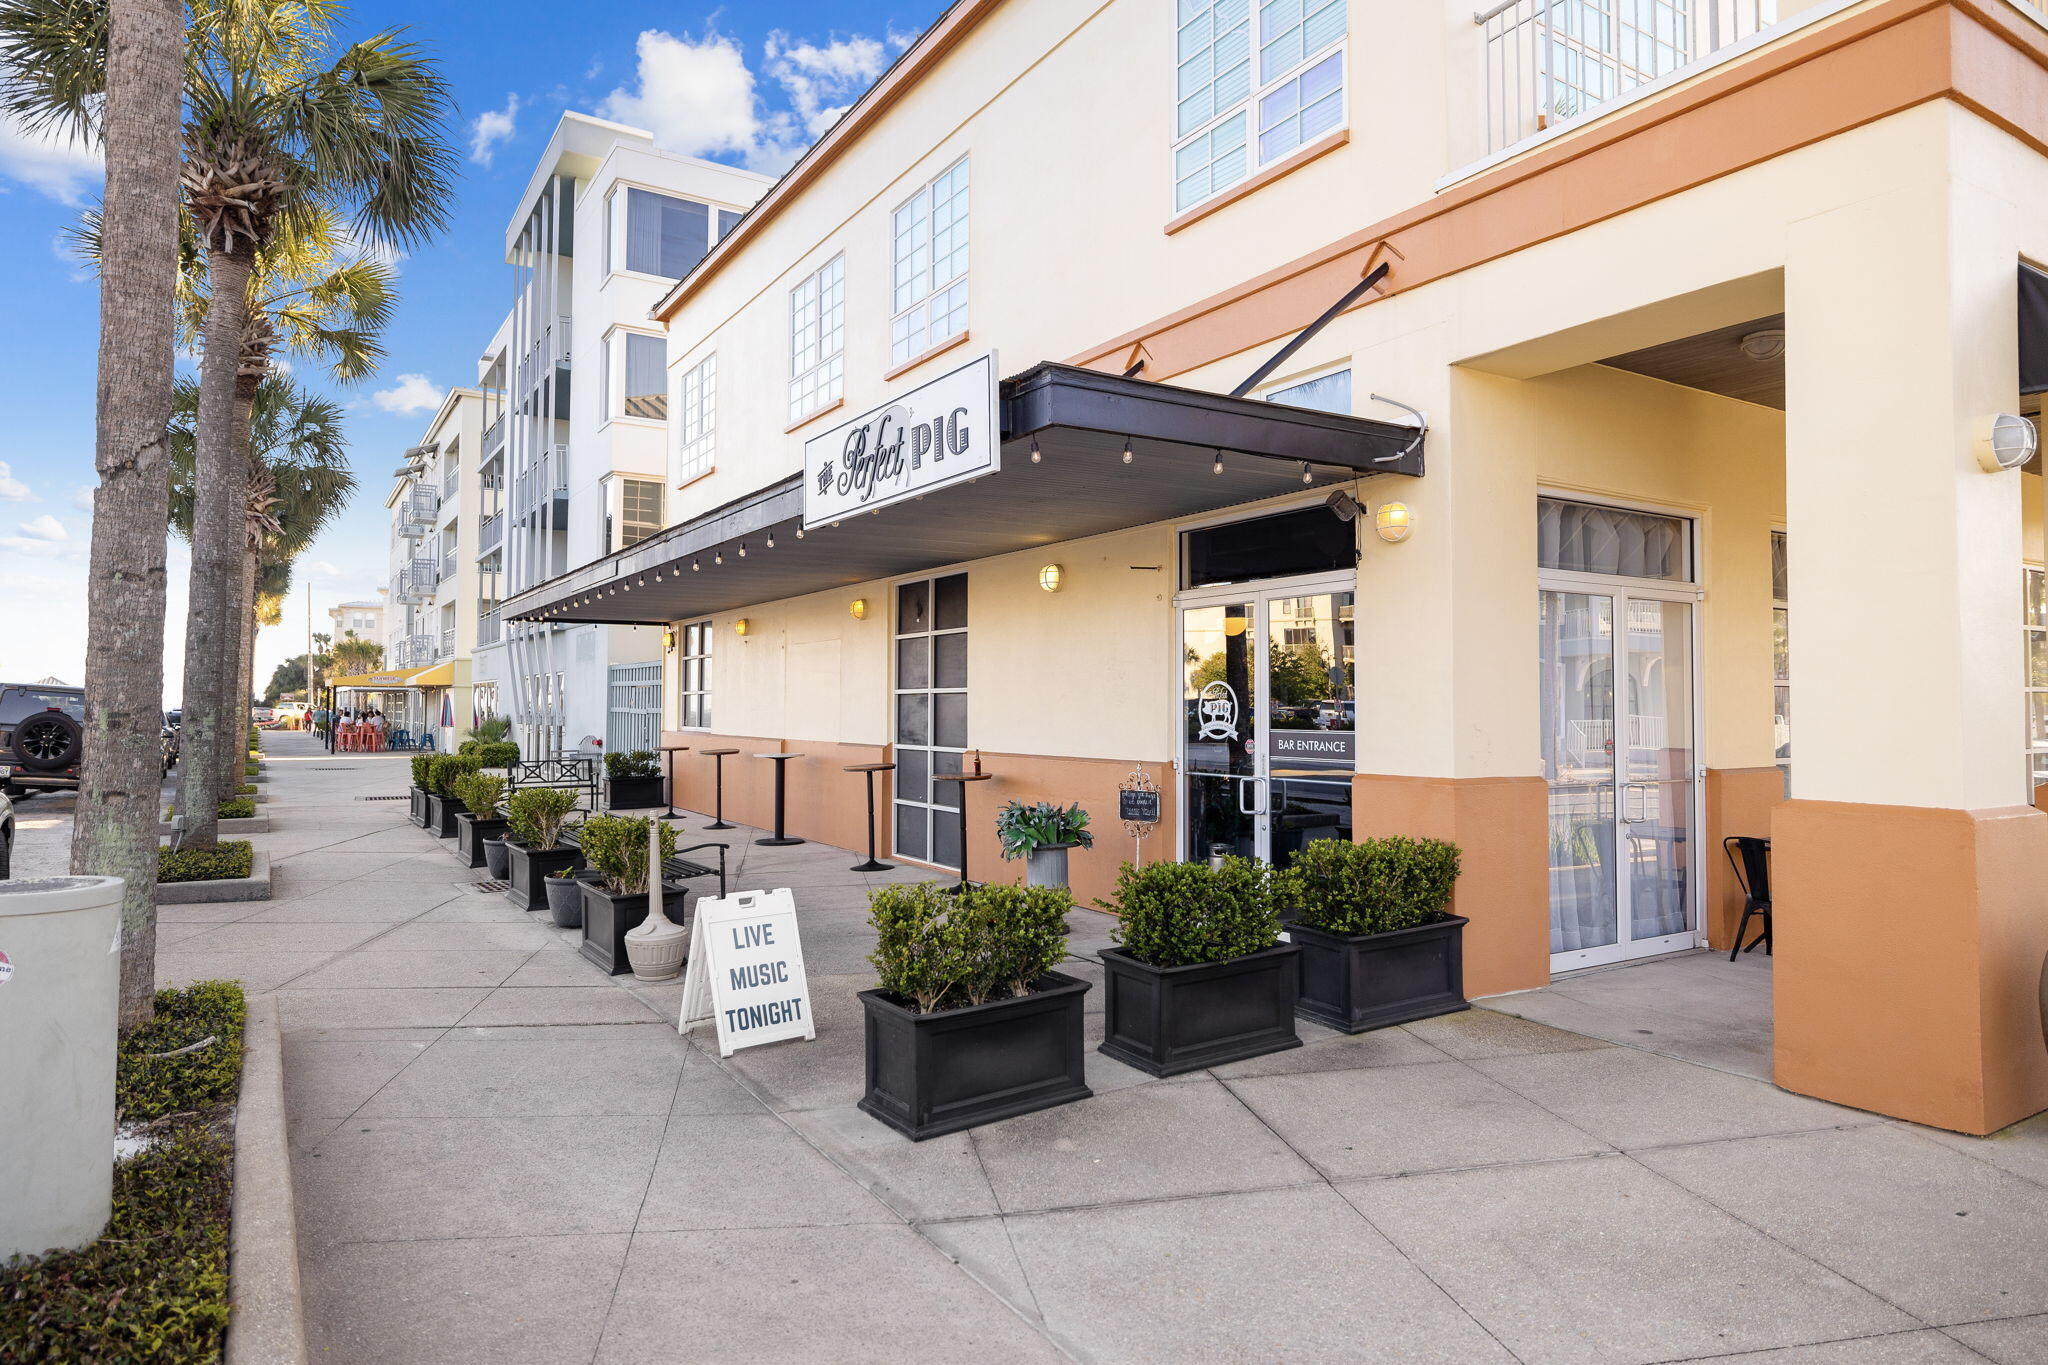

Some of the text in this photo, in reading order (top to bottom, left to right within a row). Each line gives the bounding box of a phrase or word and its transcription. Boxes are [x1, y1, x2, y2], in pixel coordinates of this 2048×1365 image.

[817, 407, 969, 502] THE Perfect PIG
[1278, 739, 1346, 752] BAR ENTRANCE
[732, 923, 775, 949] LIVE
[729, 960, 789, 991] MUSIC
[725, 998, 802, 1033] TONIGHT
